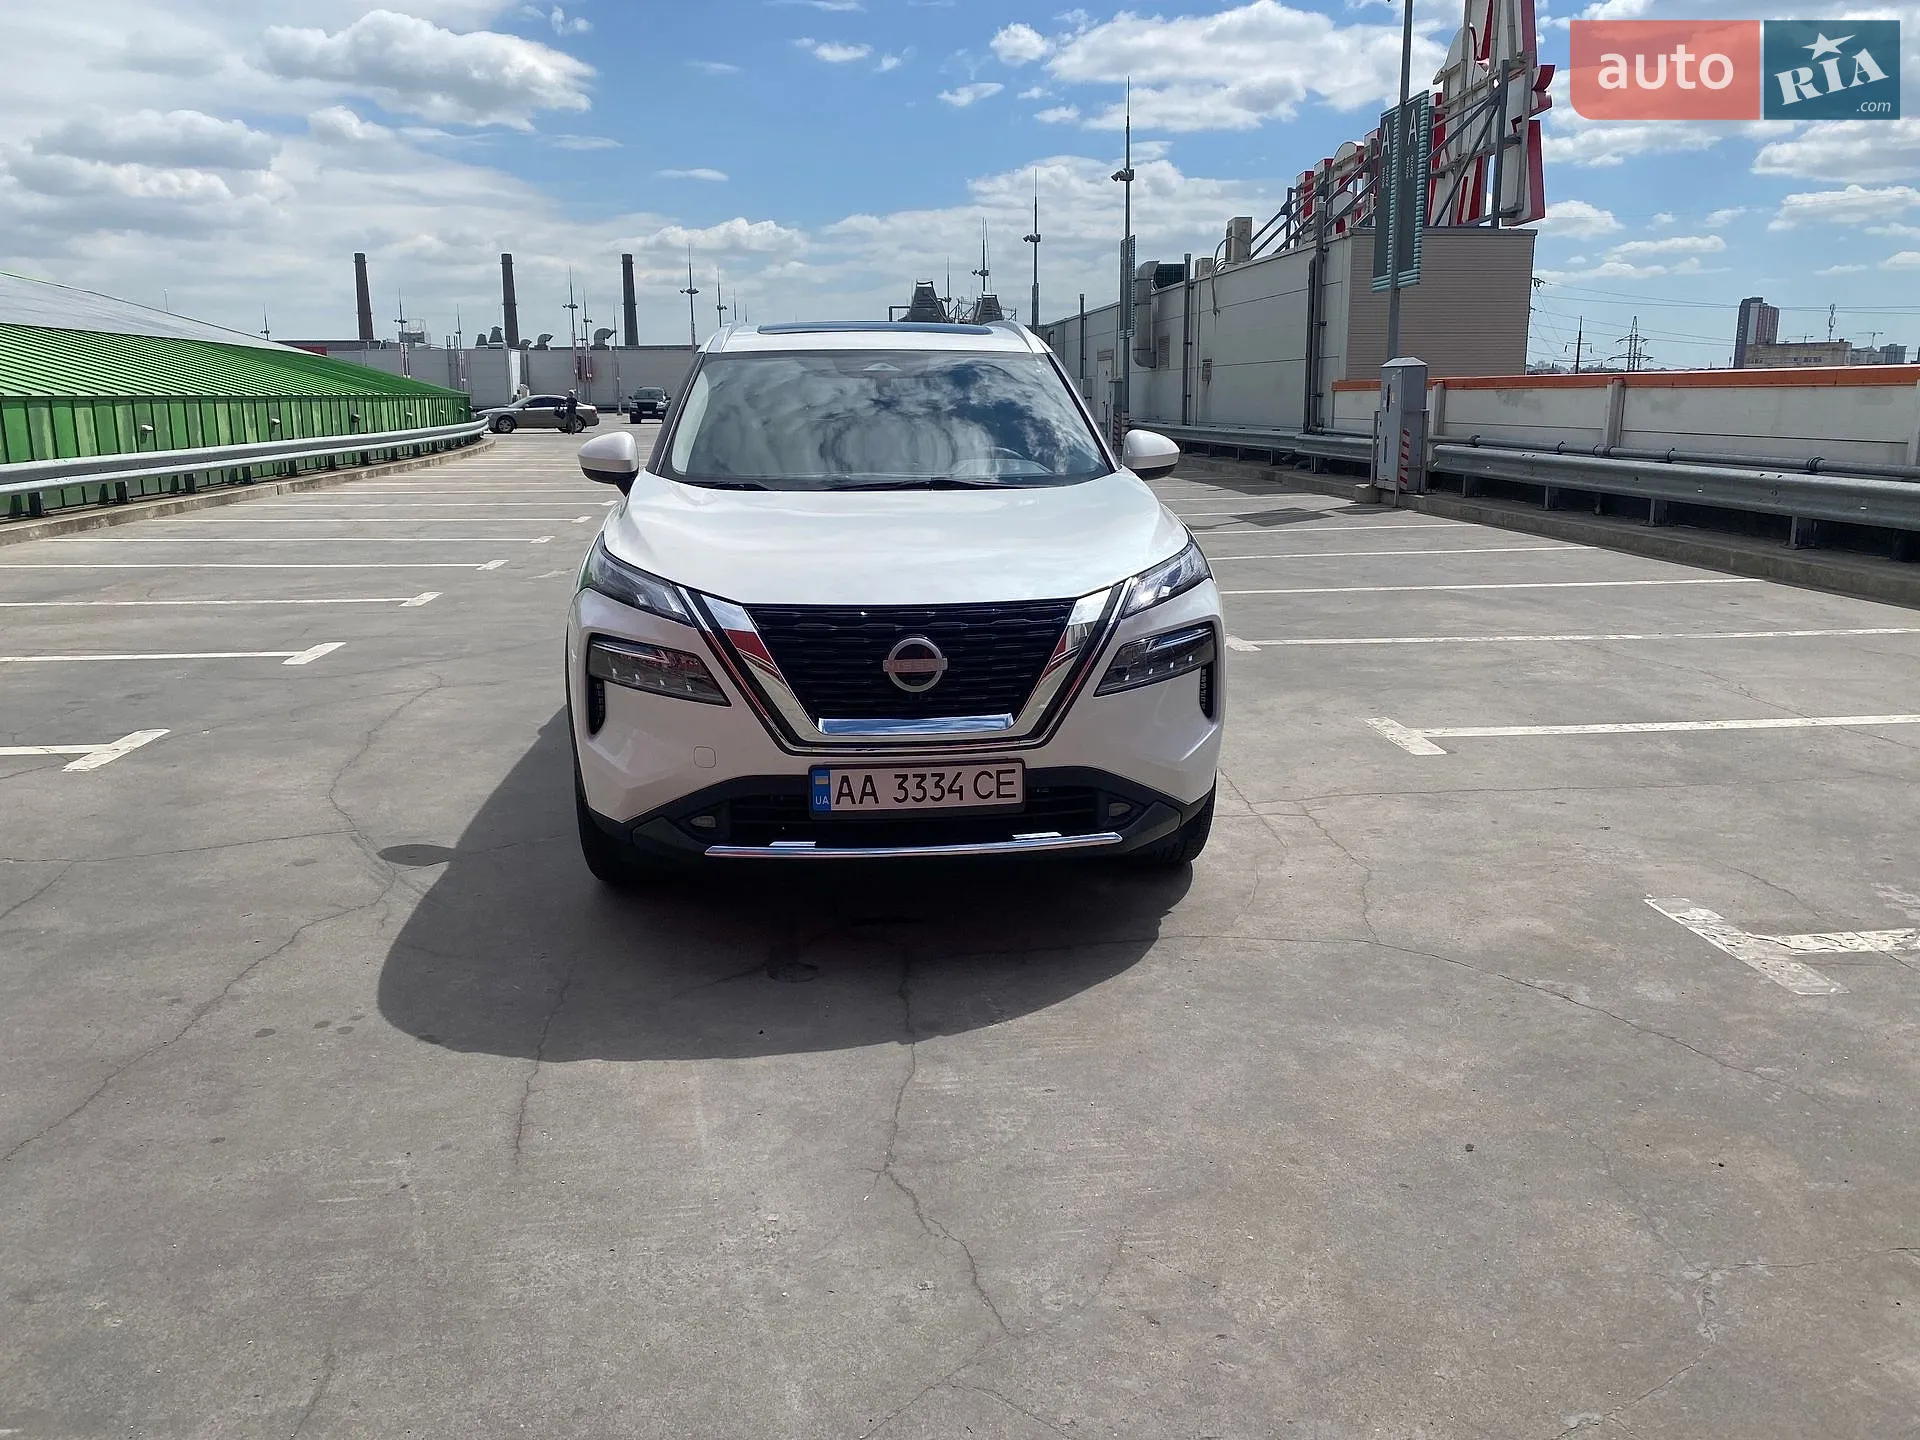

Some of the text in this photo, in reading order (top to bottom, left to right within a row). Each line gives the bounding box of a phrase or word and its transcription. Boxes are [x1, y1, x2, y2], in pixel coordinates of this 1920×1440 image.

[1380, 121, 1391, 158] A
[1407, 108, 1418, 146] A
[815, 795, 829, 805] UA
[835, 768, 1017, 805] AA 3334 CE
